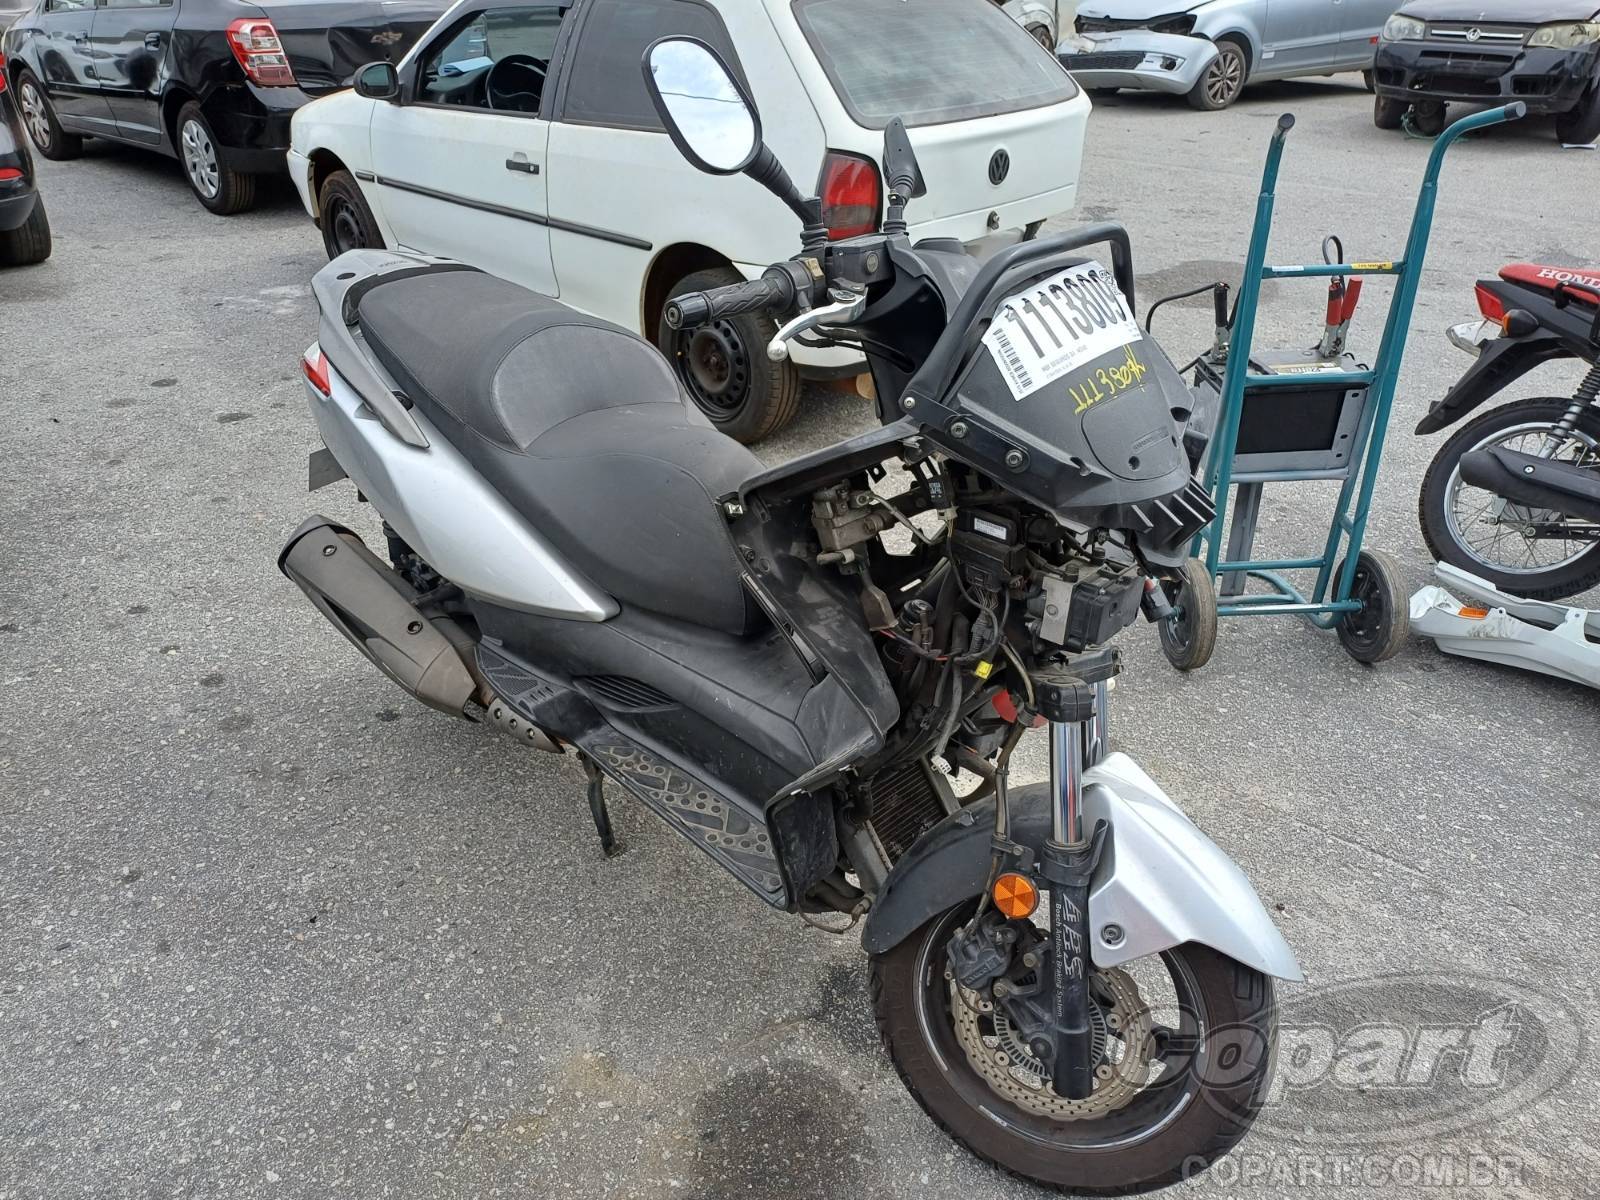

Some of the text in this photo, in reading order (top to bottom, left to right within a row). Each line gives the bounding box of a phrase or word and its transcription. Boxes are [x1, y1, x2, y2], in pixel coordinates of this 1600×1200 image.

[1004, 270, 1127, 359] 1113809
[1055, 928, 1063, 958] Antilock
[1056, 961, 1064, 989] Braking
